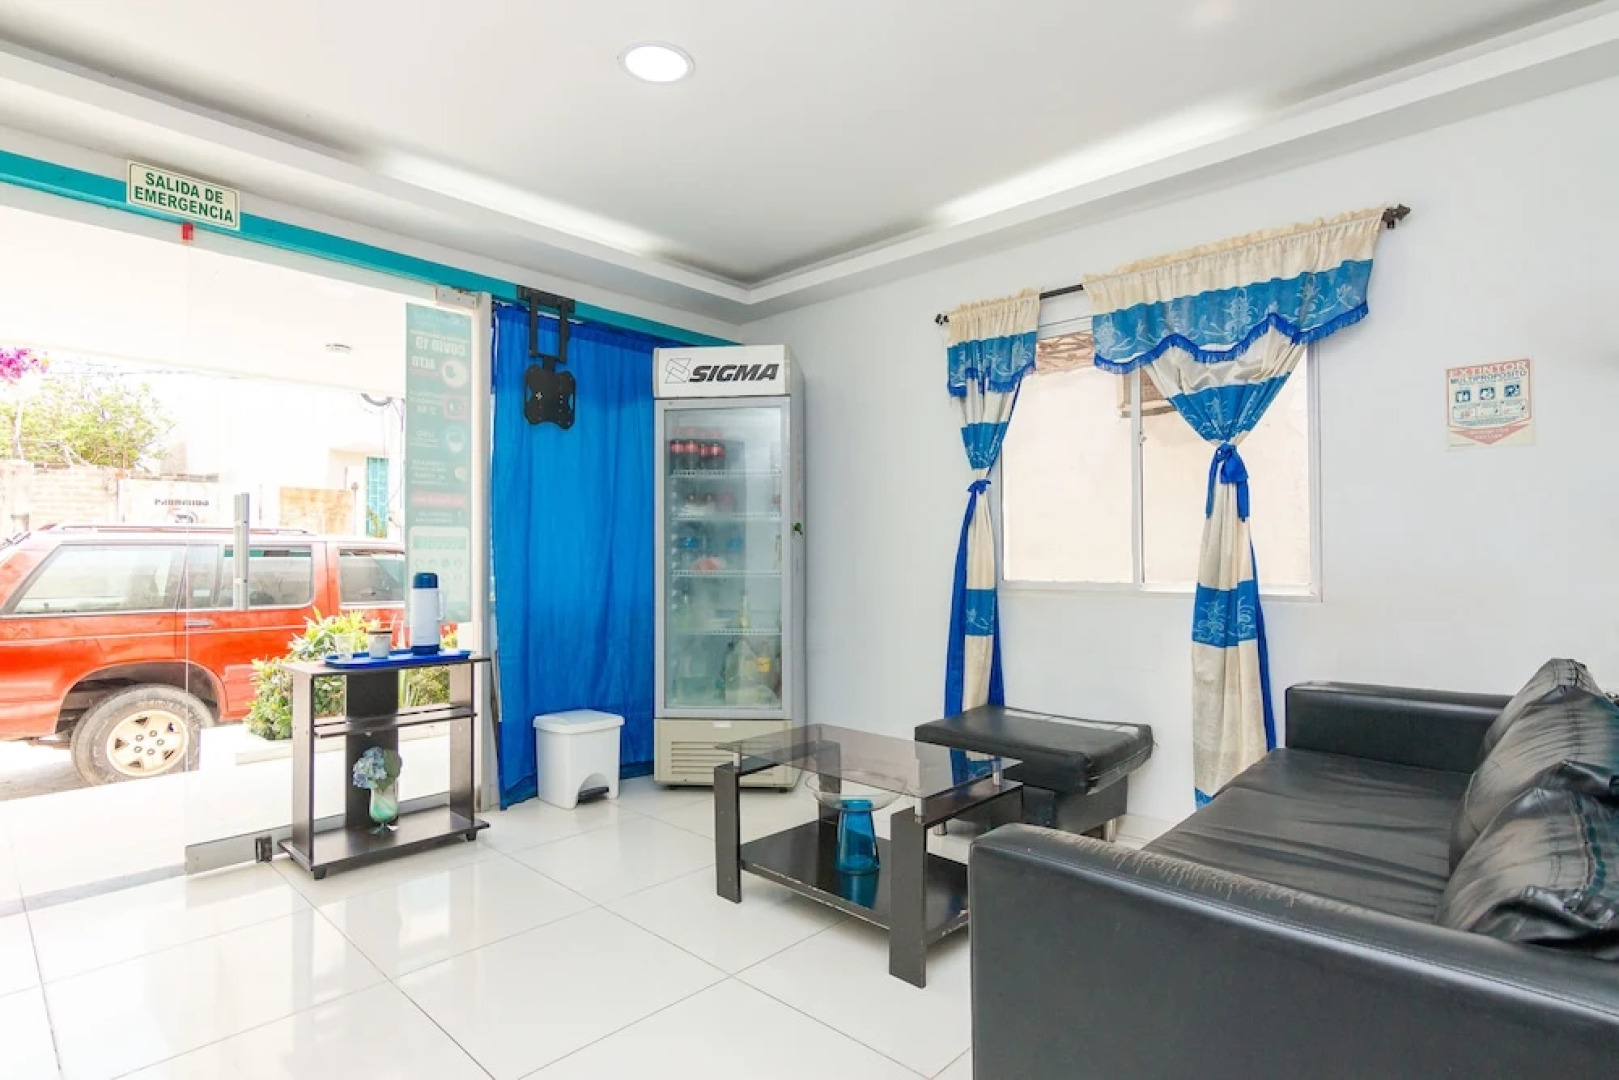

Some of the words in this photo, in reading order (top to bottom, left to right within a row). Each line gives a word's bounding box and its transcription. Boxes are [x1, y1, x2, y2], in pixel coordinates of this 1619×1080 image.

[145, 172, 200, 198] SALIDA
[205, 188, 223, 204] DE
[134, 185, 234, 222] EMERGENCIA
[689, 363, 780, 383] SIGMA
[1450, 361, 1527, 379] EXTINTOR
